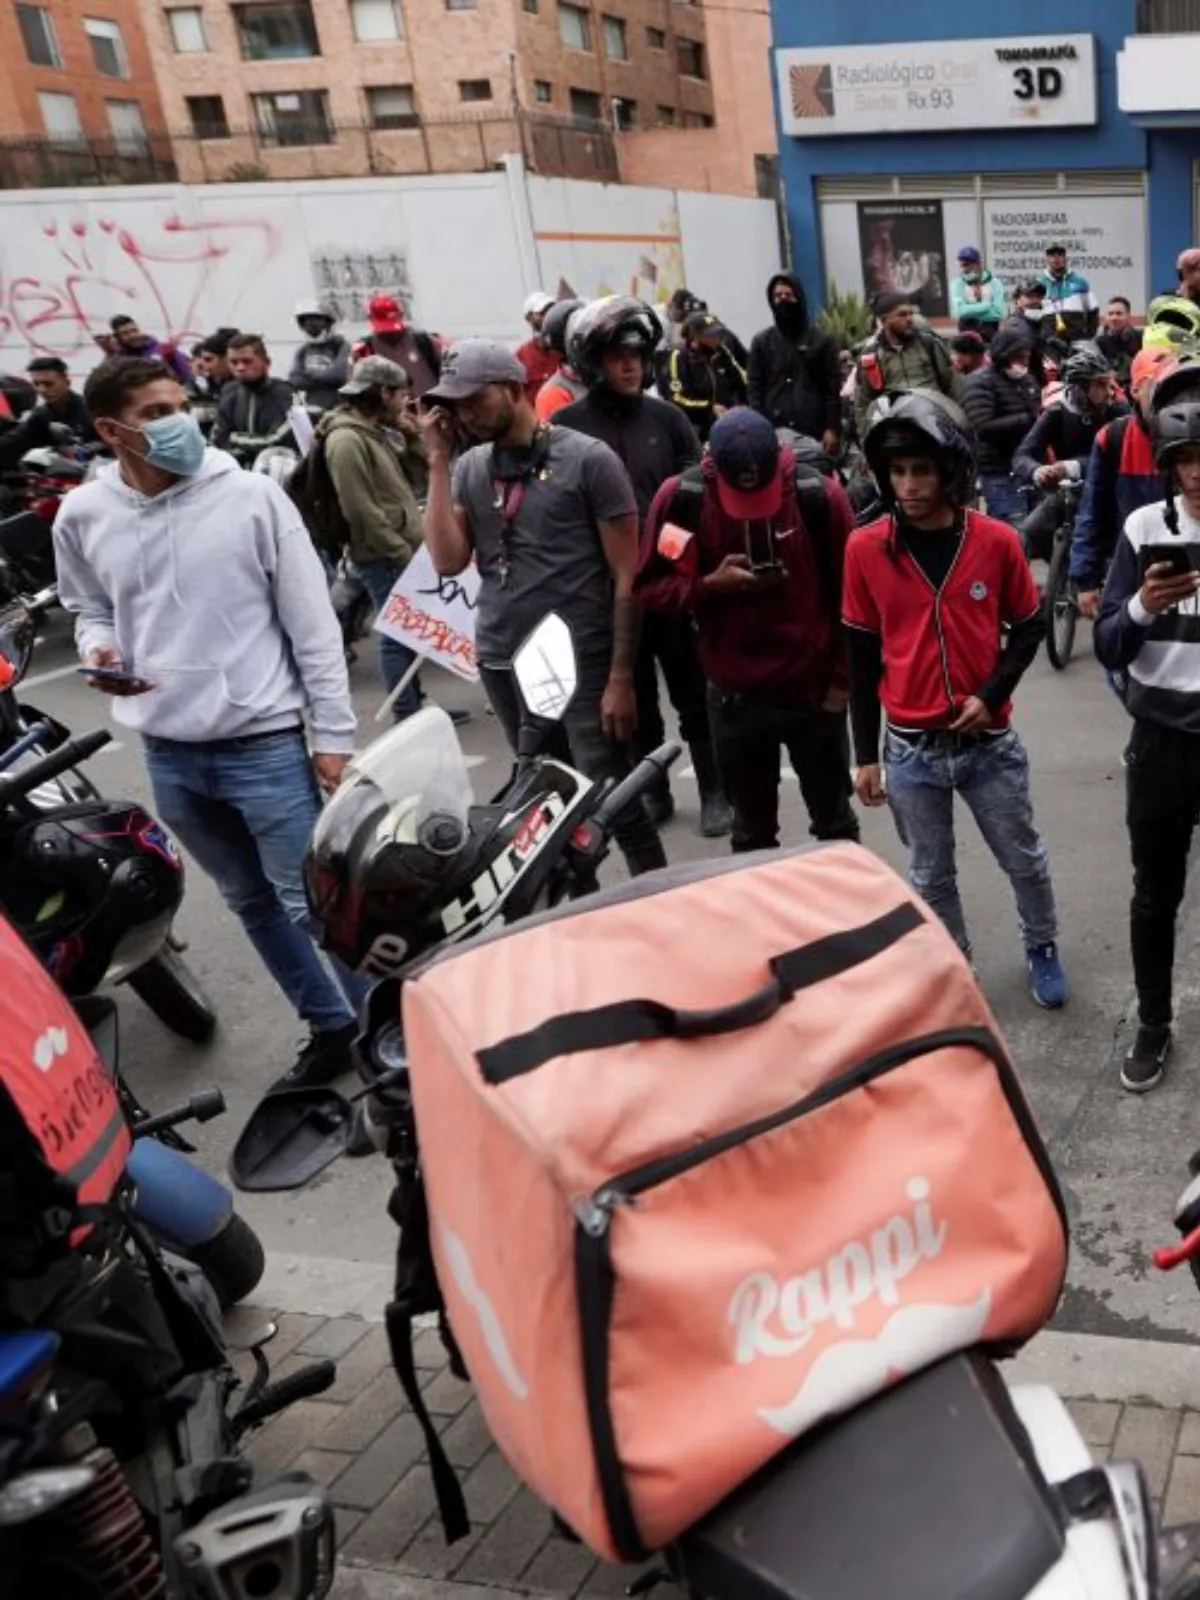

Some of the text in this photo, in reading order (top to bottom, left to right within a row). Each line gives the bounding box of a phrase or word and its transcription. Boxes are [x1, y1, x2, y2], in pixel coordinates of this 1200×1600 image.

[836, 62, 936, 87] Radiológico
[1012, 66, 1063, 99] 3D
[728, 1175, 950, 1367] Rappi
